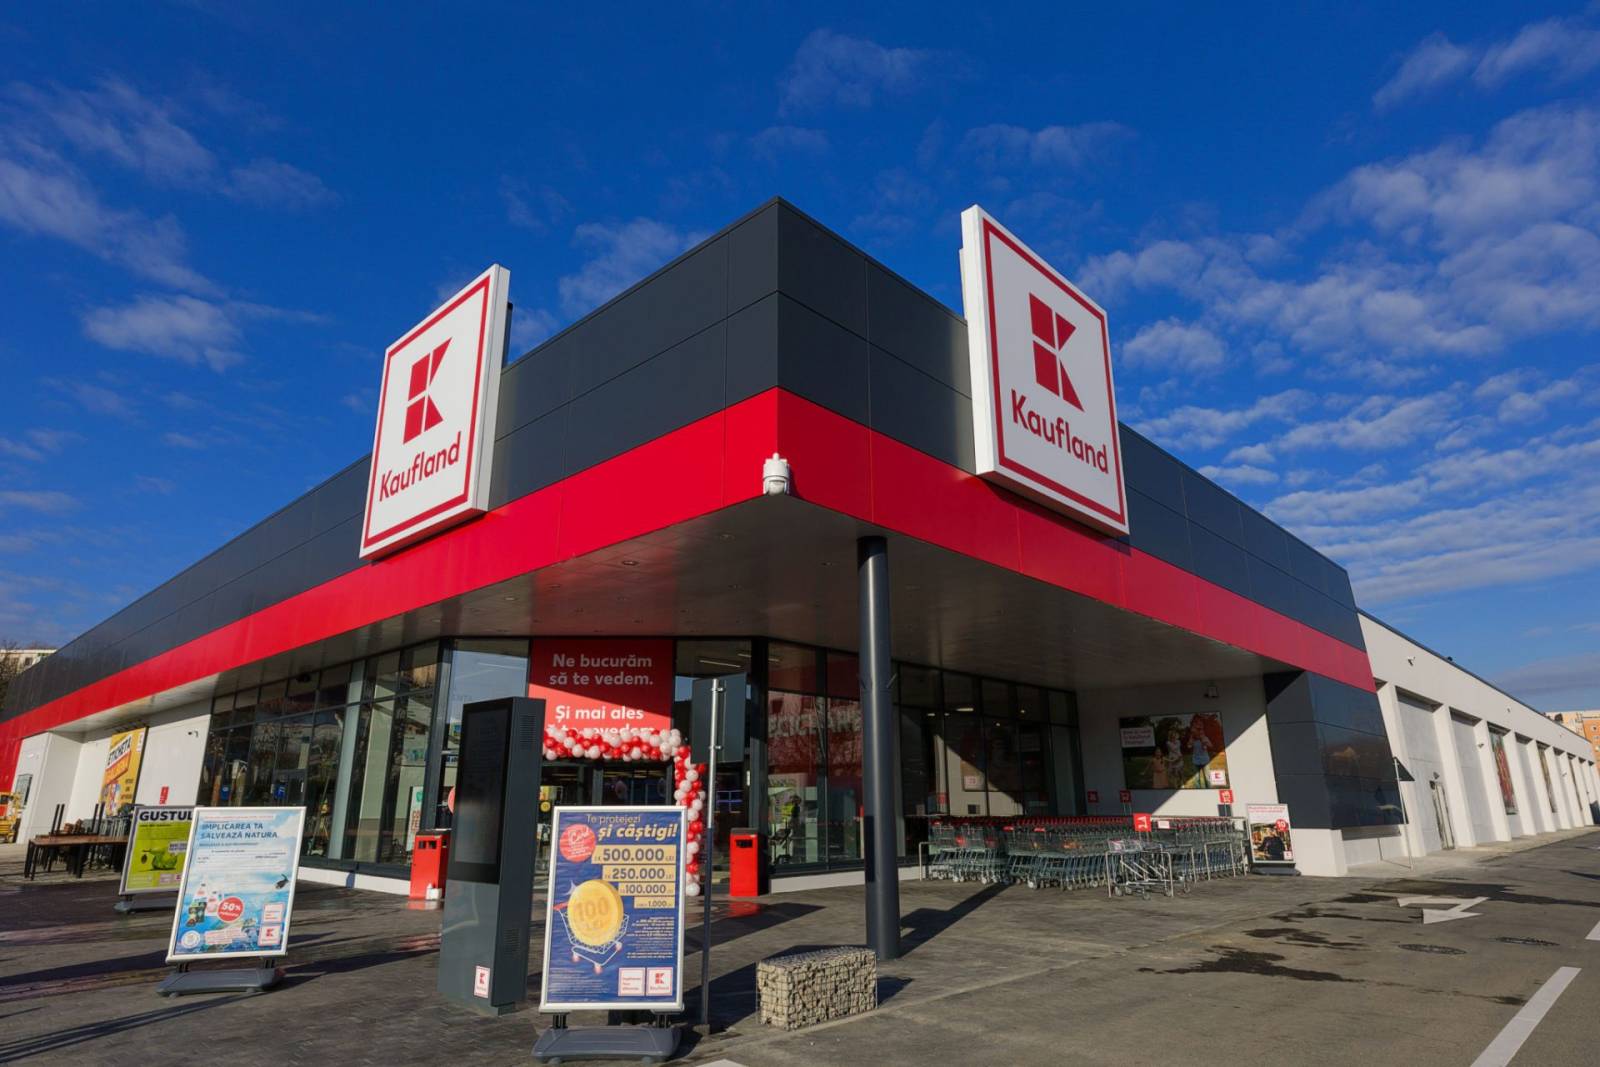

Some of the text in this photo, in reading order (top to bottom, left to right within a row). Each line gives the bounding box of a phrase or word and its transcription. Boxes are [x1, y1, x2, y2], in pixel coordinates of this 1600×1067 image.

[1011, 388, 1109, 474] Kaufland
[379, 431, 461, 501] Kaufland
[552, 654, 652, 668] Ne bucurăm
[549, 672, 653, 685] să te vedem.
[575, 706, 606, 719] mai
[610, 706, 644, 719] ales
[140, 811, 192, 821] GUSTUL
[585, 814, 641, 824] Te protejezi
[245, 831, 278, 839] NATURA
[598, 824, 613, 841] și
[603, 848, 664, 861] 500.000
[612, 868, 665, 879] 250.000
[625, 884, 666, 894] 100.000
